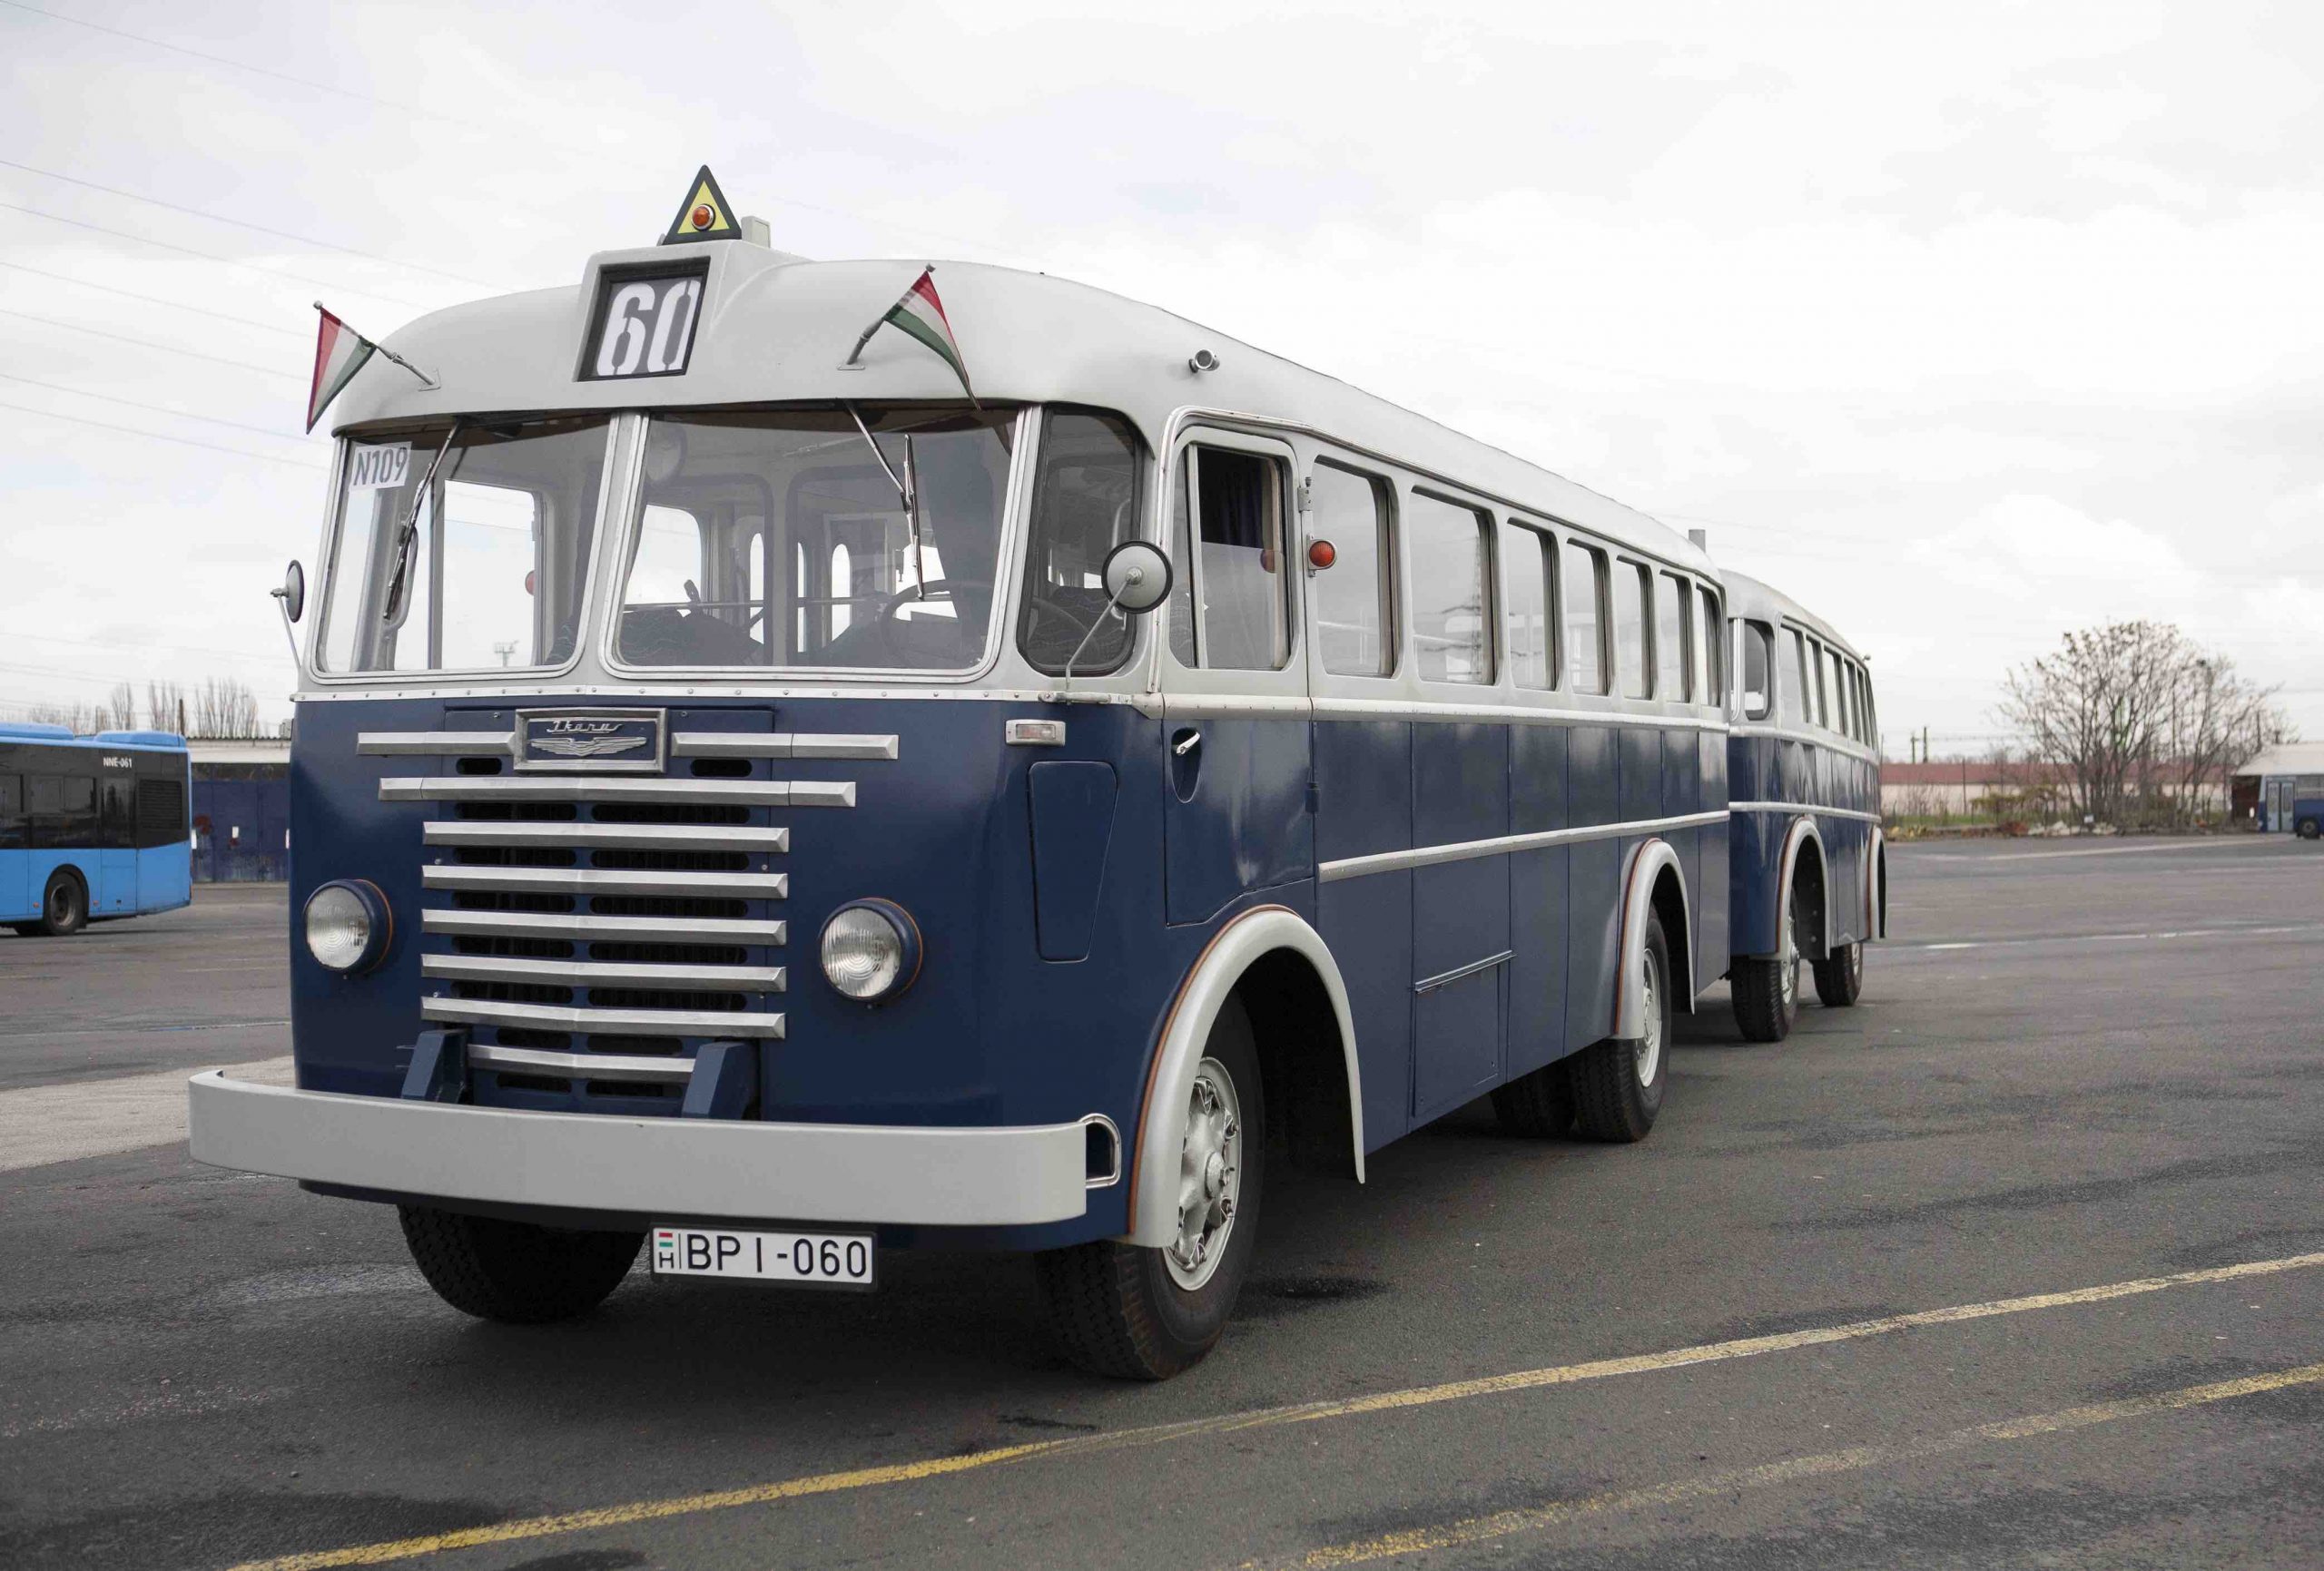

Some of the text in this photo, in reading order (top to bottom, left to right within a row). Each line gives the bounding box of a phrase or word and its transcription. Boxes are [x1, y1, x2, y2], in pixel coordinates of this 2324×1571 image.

[596, 280, 701, 376] 60
[353, 447, 408, 486] N109
[547, 720, 623, 733] Ikarus
[103, 757, 133, 768] NNE-061
[659, 1233, 866, 1277] H BPI-060
